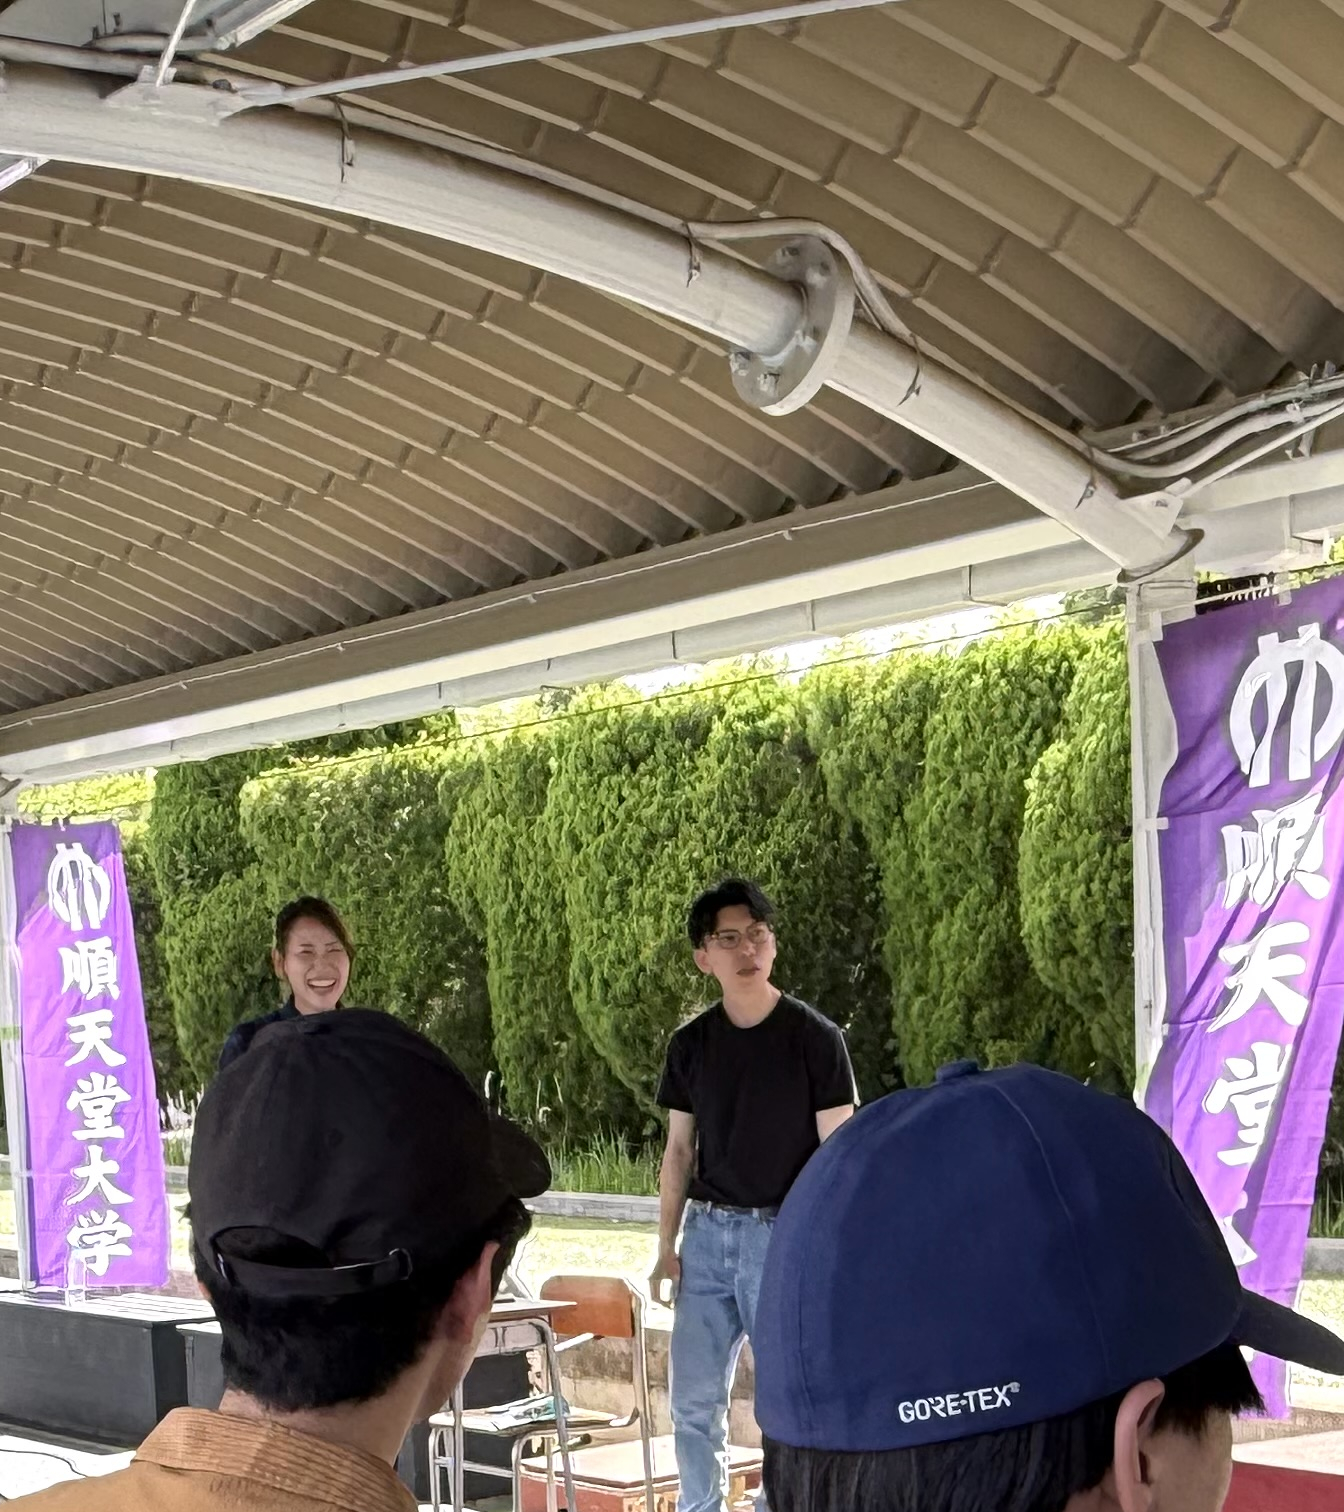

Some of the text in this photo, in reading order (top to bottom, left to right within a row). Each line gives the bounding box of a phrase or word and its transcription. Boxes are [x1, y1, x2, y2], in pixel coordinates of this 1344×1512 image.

[59, 937, 134, 1277] 順天堂大学
